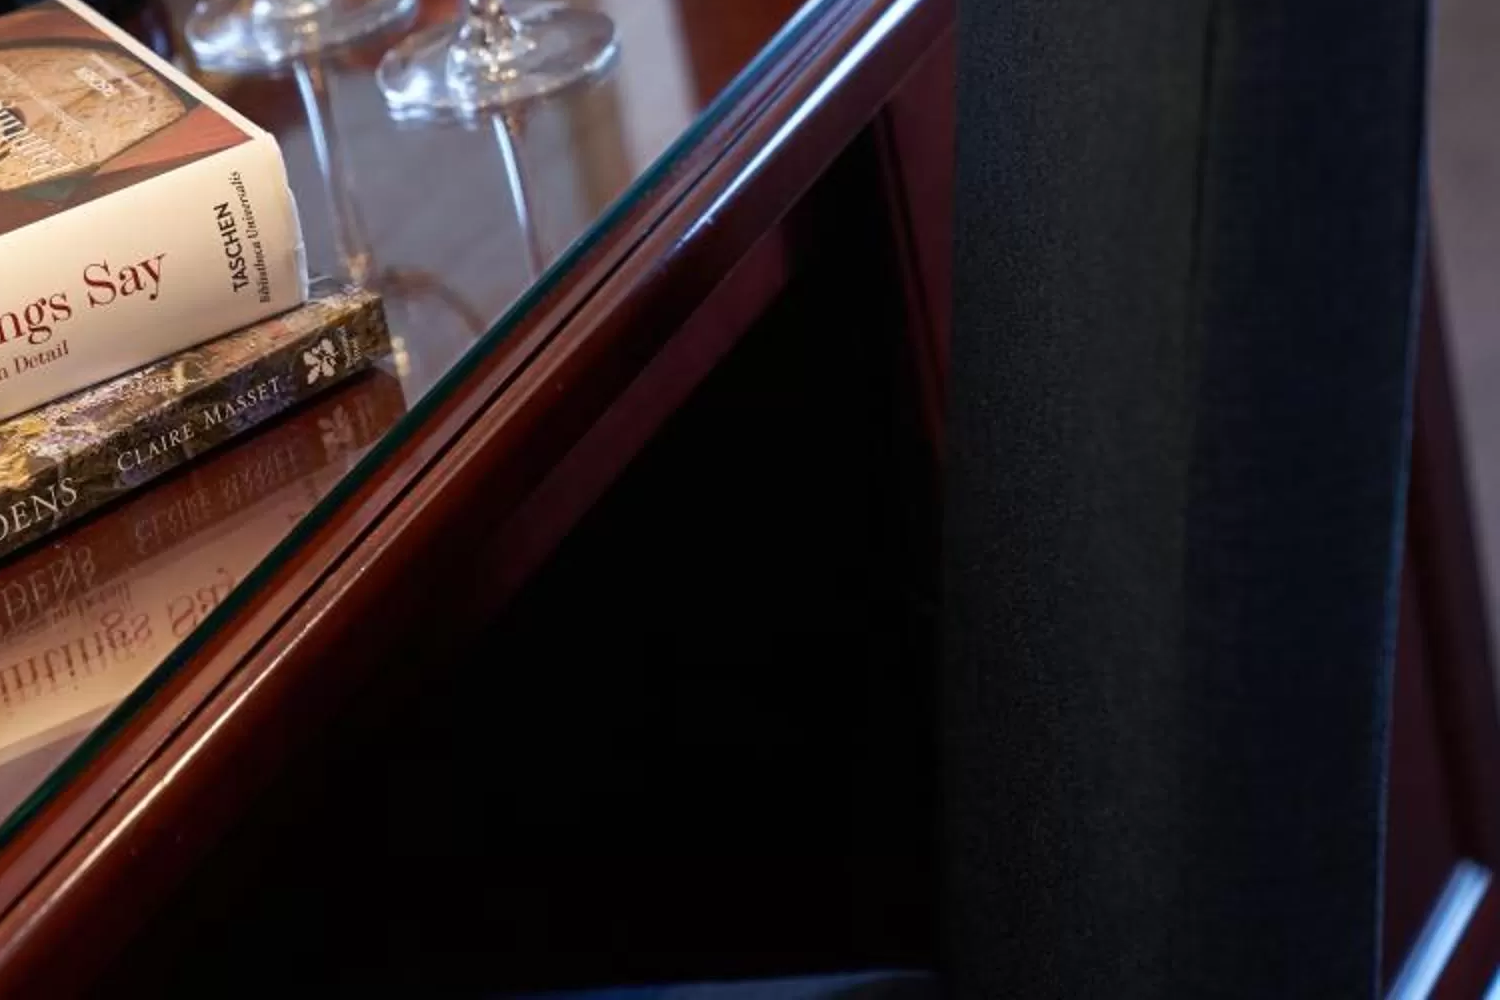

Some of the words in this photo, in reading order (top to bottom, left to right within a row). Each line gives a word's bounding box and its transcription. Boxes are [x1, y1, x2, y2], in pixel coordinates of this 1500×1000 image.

[228, 171, 259, 239] Universalis
[83, 252, 167, 308] Say
[213, 202, 249, 292] TASCHEN
[14, 340, 70, 375] Detail
[116, 420, 194, 473] CLAIRE
[202, 375, 281, 431] MASSET
